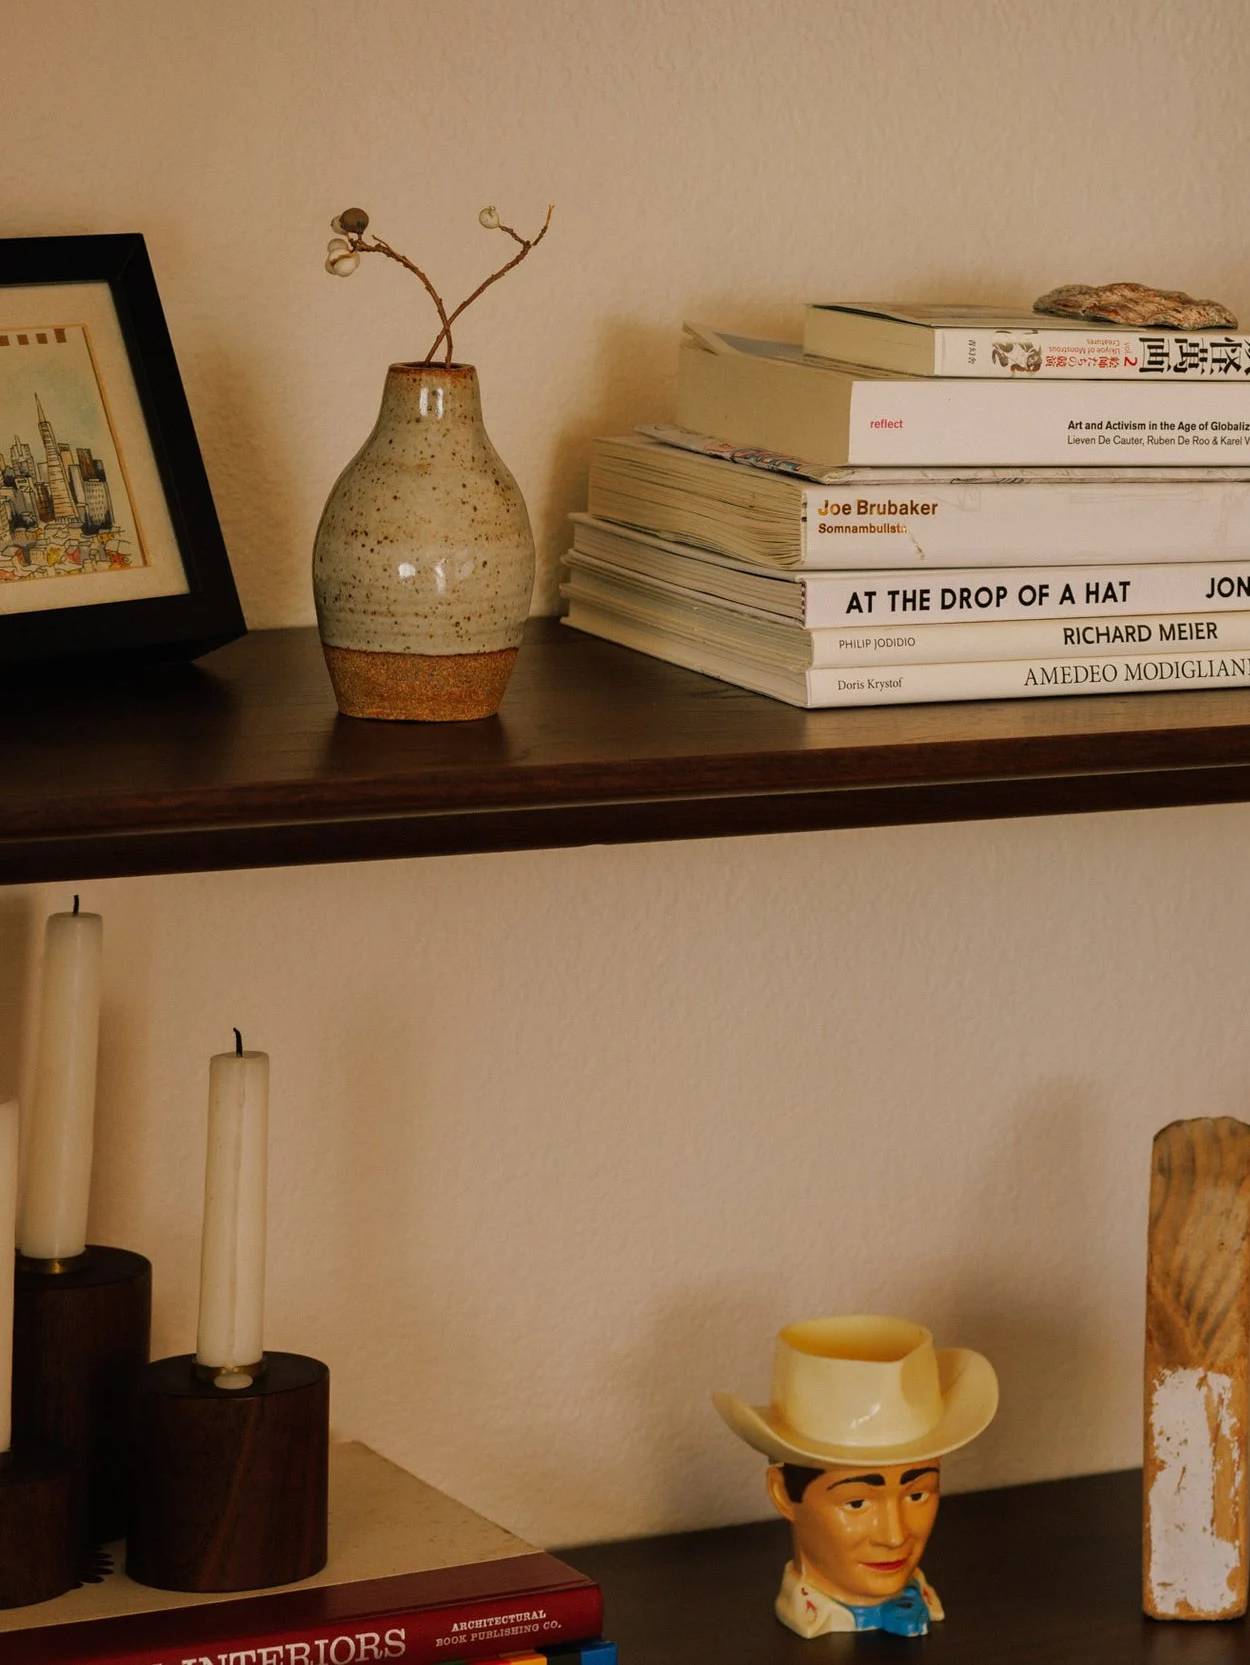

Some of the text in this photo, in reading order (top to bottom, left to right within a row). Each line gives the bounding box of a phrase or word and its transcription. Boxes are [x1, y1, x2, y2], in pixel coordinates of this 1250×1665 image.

[1124, 356, 1138, 367] 2
[870, 419, 904, 429] reflect
[1067, 420, 1083, 430] Art
[1085, 420, 1102, 430] and
[1105, 420, 1146, 431] Activism
[1149, 421, 1158, 430] in
[1160, 421, 1175, 431] the
[1178, 421, 1197, 432] Age
[1198, 421, 1209, 431] of
[1067, 435, 1096, 445] Lieven
[1098, 435, 1111, 445] De
[1113, 436, 1145, 446] Cauter,
[1147, 435, 1175, 445] Ruben
[1178, 436, 1190, 445] De
[1192, 436, 1210, 445] Roo
[1212, 436, 1219, 445] &
[1221, 436, 1242, 445] Karel
[818, 499, 938, 516] Joe Brubaker
[846, 591, 876, 614] AT
[887, 588, 931, 613] THE
[940, 586, 1008, 610] DROP
[1018, 584, 1050, 607] OF
[1059, 583, 1076, 605] A
[1085, 581, 1131, 605] HAT
[1205, 577, 1250, 599] JON
[839, 639, 872, 649] PHILIP
[873, 637, 916, 650] JODIDIO
[1063, 625, 1152, 645] RICHARD
[1158, 622, 1218, 641] MEIER
[837, 679, 865, 691] Doris
[867, 677, 903, 692] Krystof
[1023, 664, 1118, 686] AMEDEO
[451, 1609, 546, 1632] ARCHITECTURAL
[435, 1621, 563, 1648] BOOK PUBLISHING CO.
